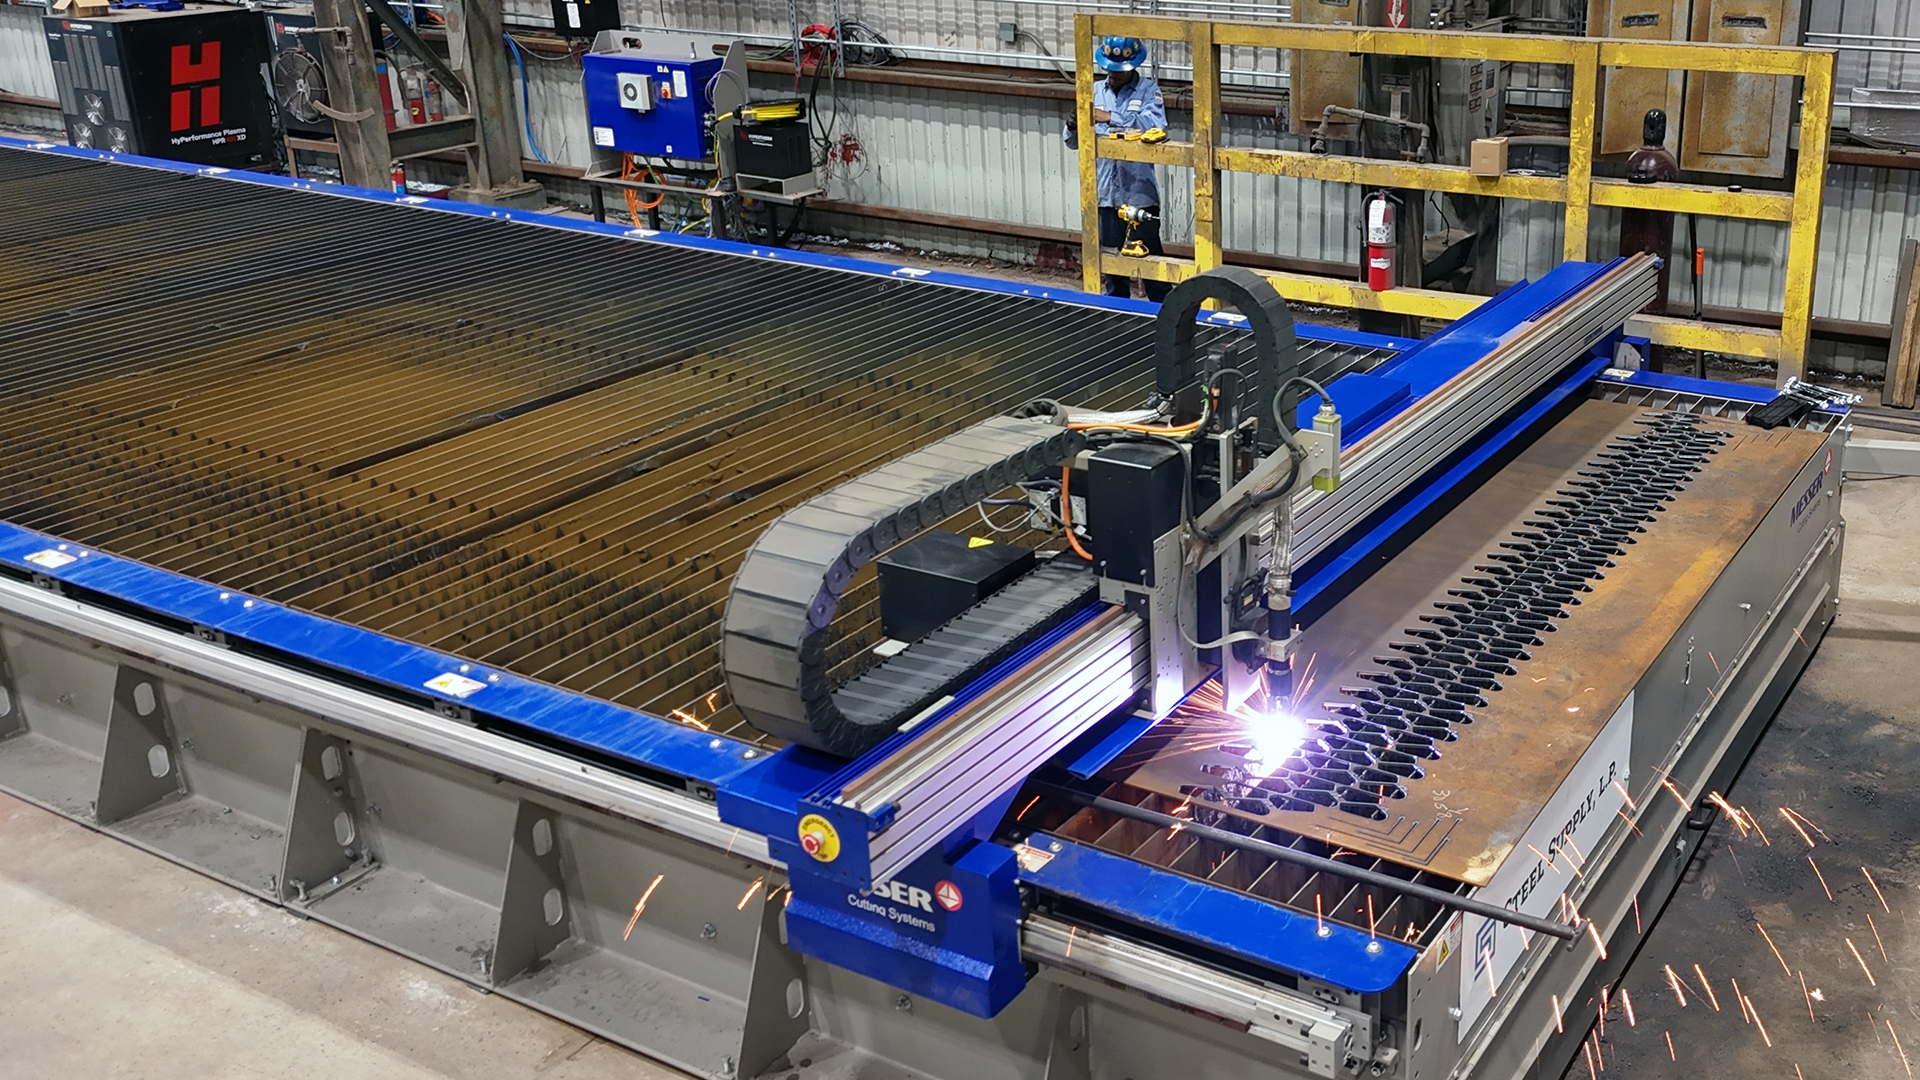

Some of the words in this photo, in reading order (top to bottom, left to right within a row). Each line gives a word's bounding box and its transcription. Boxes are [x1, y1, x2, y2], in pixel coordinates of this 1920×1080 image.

[223, 127, 246, 136] Plasma
[1790, 471, 1823, 528] MESSER
[1598, 761, 1617, 797] L.P.
[847, 893, 887, 917] Cutting
[888, 907, 936, 932] Systems
[873, 880, 934, 914] SER
